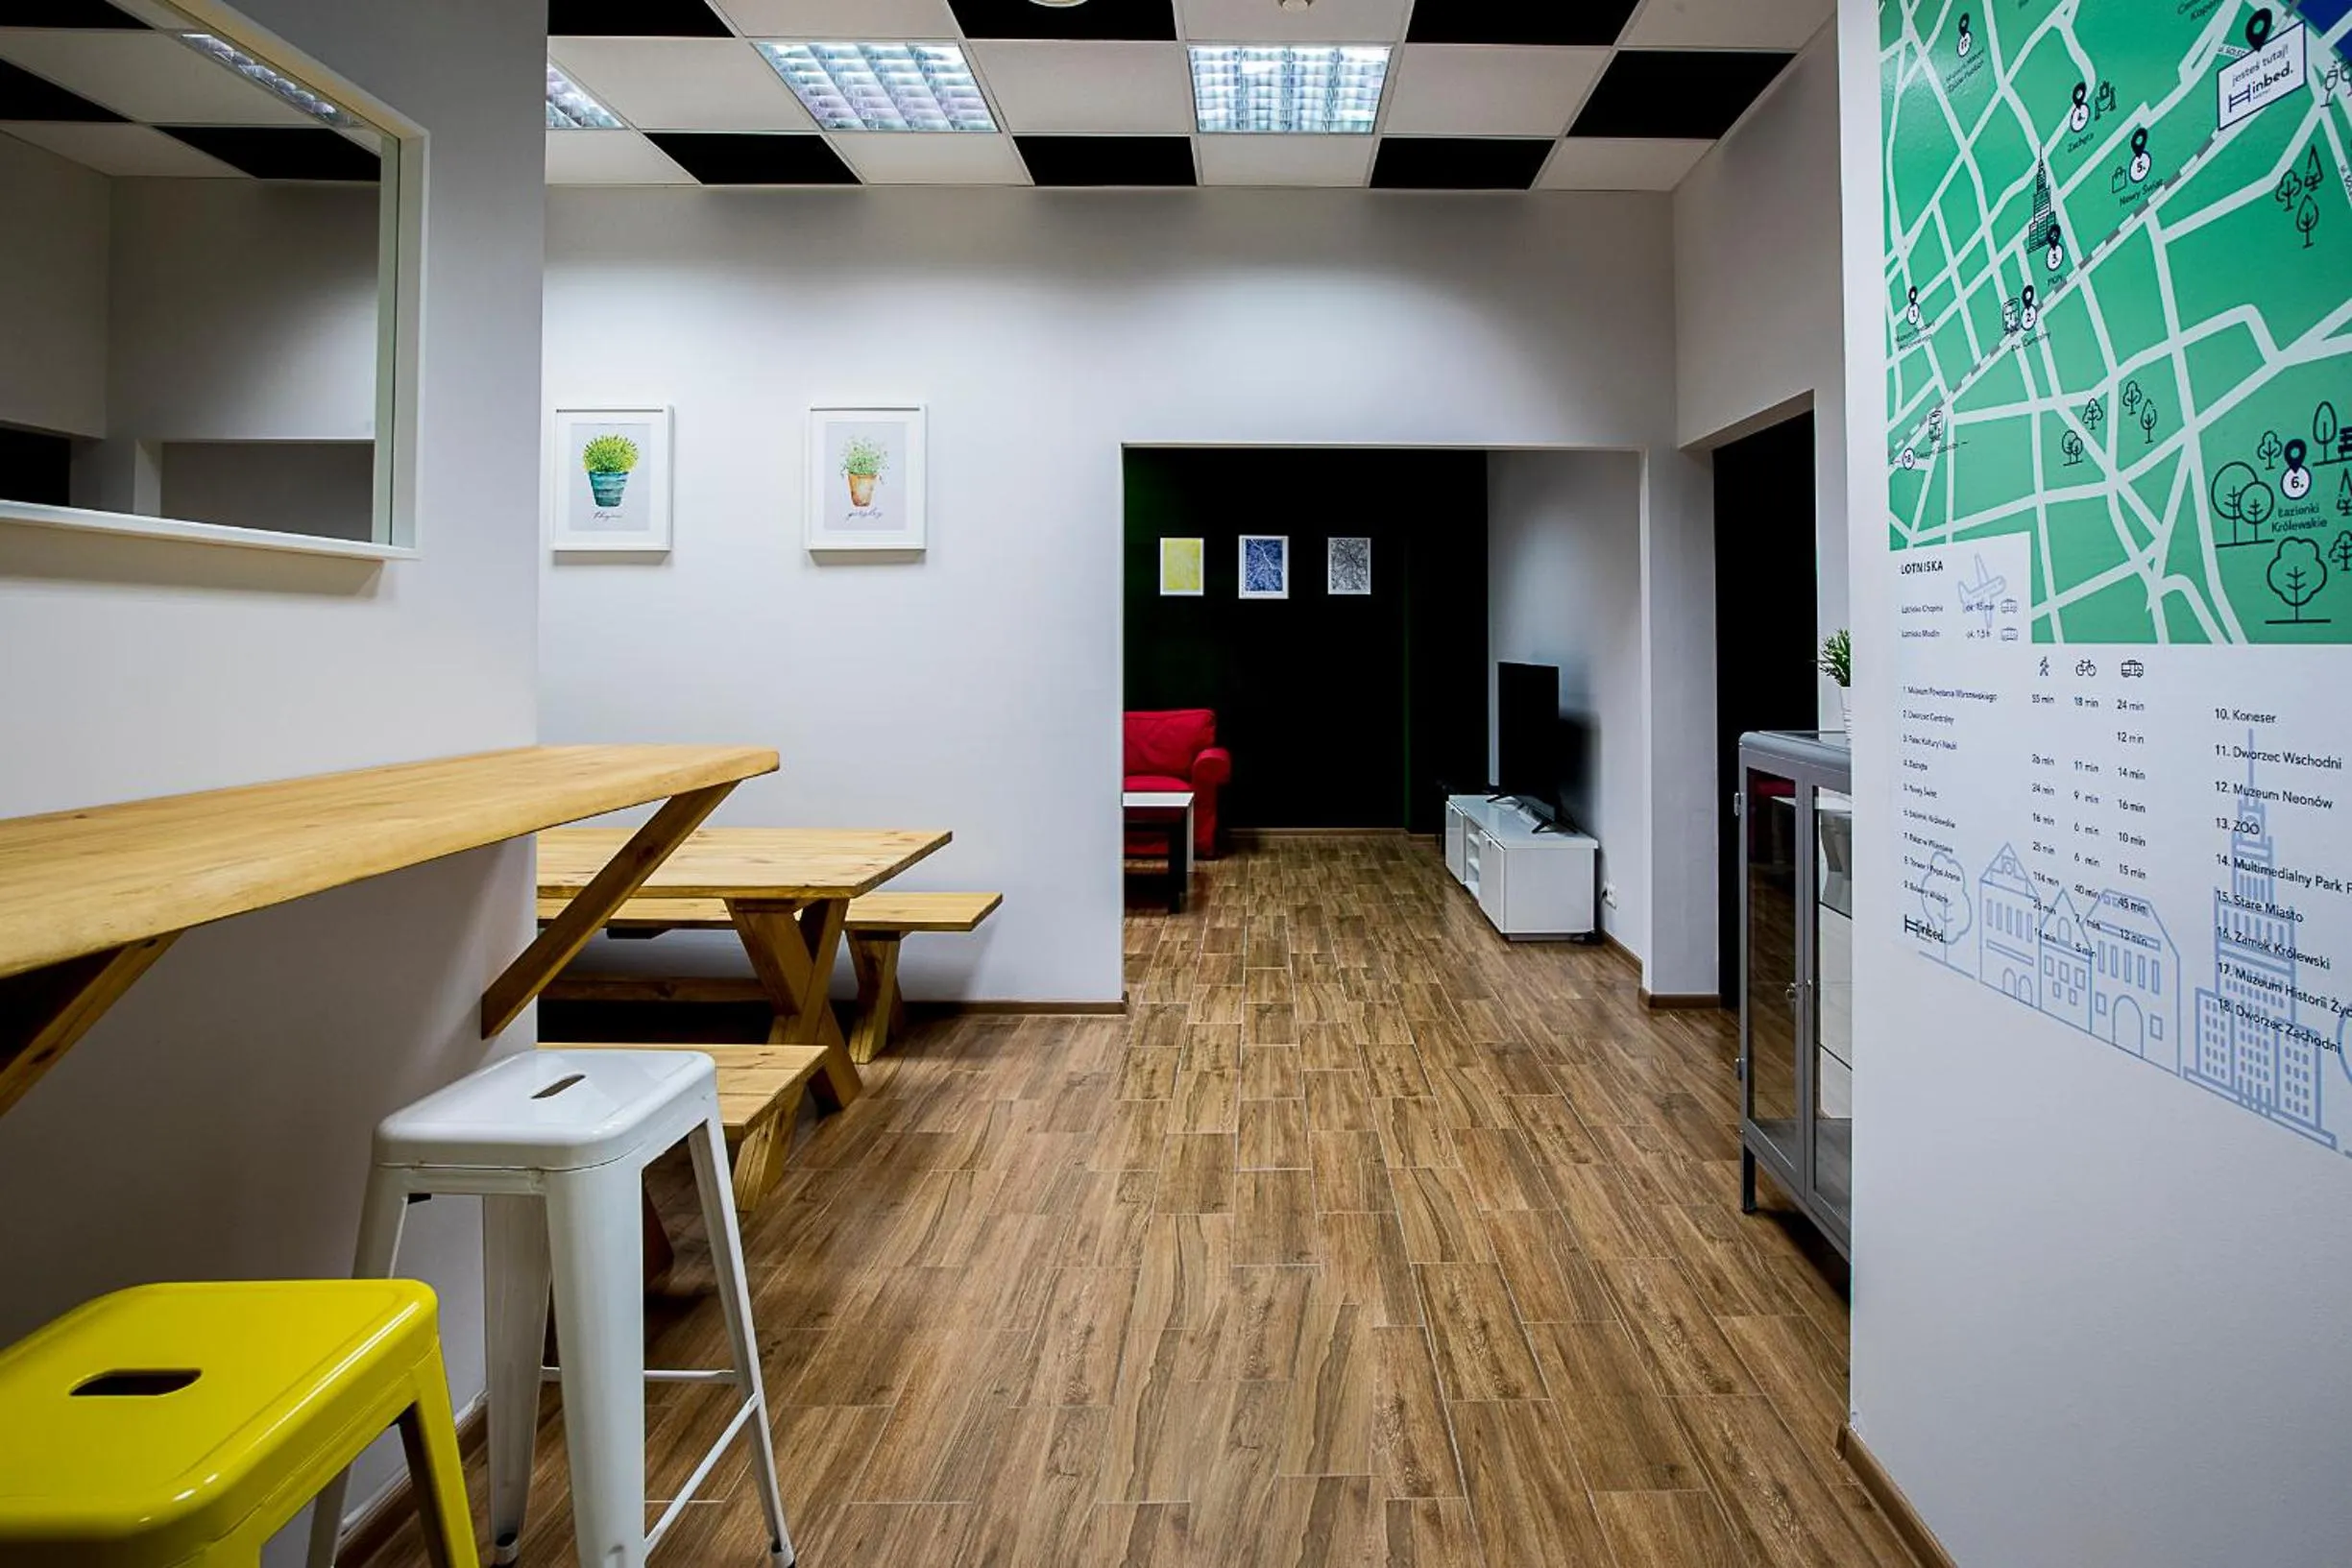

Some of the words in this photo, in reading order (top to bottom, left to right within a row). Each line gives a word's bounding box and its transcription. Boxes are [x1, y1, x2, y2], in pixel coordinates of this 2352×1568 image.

[2232, 61, 2261, 86] jesteś
[2262, 43, 2289, 66] tutaj!
[2137, 161, 2146, 173] 5.
[2291, 476, 2304, 489] 6.
[1902, 561, 1944, 575] LOTNISKA
[2117, 699, 2127, 711] 24
[2129, 701, 2145, 711] min
[2215, 709, 2229, 720] 10.
[2232, 710, 2276, 723] Koneser
[2117, 732, 2127, 742] 12
[2128, 732, 2145, 743] min
[2215, 744, 2230, 757] 11.
[2232, 746, 2281, 762] Dworzec
[2283, 751, 2342, 769] Wschodni
[2074, 760, 2083, 770] 11
[2118, 767, 2127, 778] 14
[2129, 769, 2146, 780] min
[2215, 781, 2230, 792] 12.
[2233, 784, 2279, 801] Muzeum
[2282, 790, 2333, 808] Neonów
[2119, 799, 2129, 810] 16
[2130, 802, 2146, 813] min
[2073, 822, 2079, 832] 6
[2216, 817, 2230, 830] 13.
[2233, 820, 2260, 835] ZOO
[2119, 832, 2128, 843] 10
[2130, 835, 2146, 847] min
[2073, 853, 2080, 861] 6
[2085, 856, 2100, 867] min
[2119, 863, 2128, 876] 15
[2130, 868, 2146, 880] min
[2217, 854, 2231, 866] 14.
[2233, 857, 2312, 888] Multimedialny
[2316, 875, 2343, 893] Park
[2217, 890, 2232, 904] 15.
[2234, 895, 2263, 912] Stare
[2266, 903, 2303, 923] Miasto
[2217, 926, 2232, 941] 16.
[2235, 930, 2271, 953] Zamek
[2274, 943, 2331, 970] Królewski
[2219, 962, 2233, 977] 17.
[2235, 967, 2283, 993] Muzeum
[2286, 984, 2327, 1009] Historii
[2236, 1004, 2284, 1033] Dworzec
[2285, 1023, 2341, 1054] Zachodni
